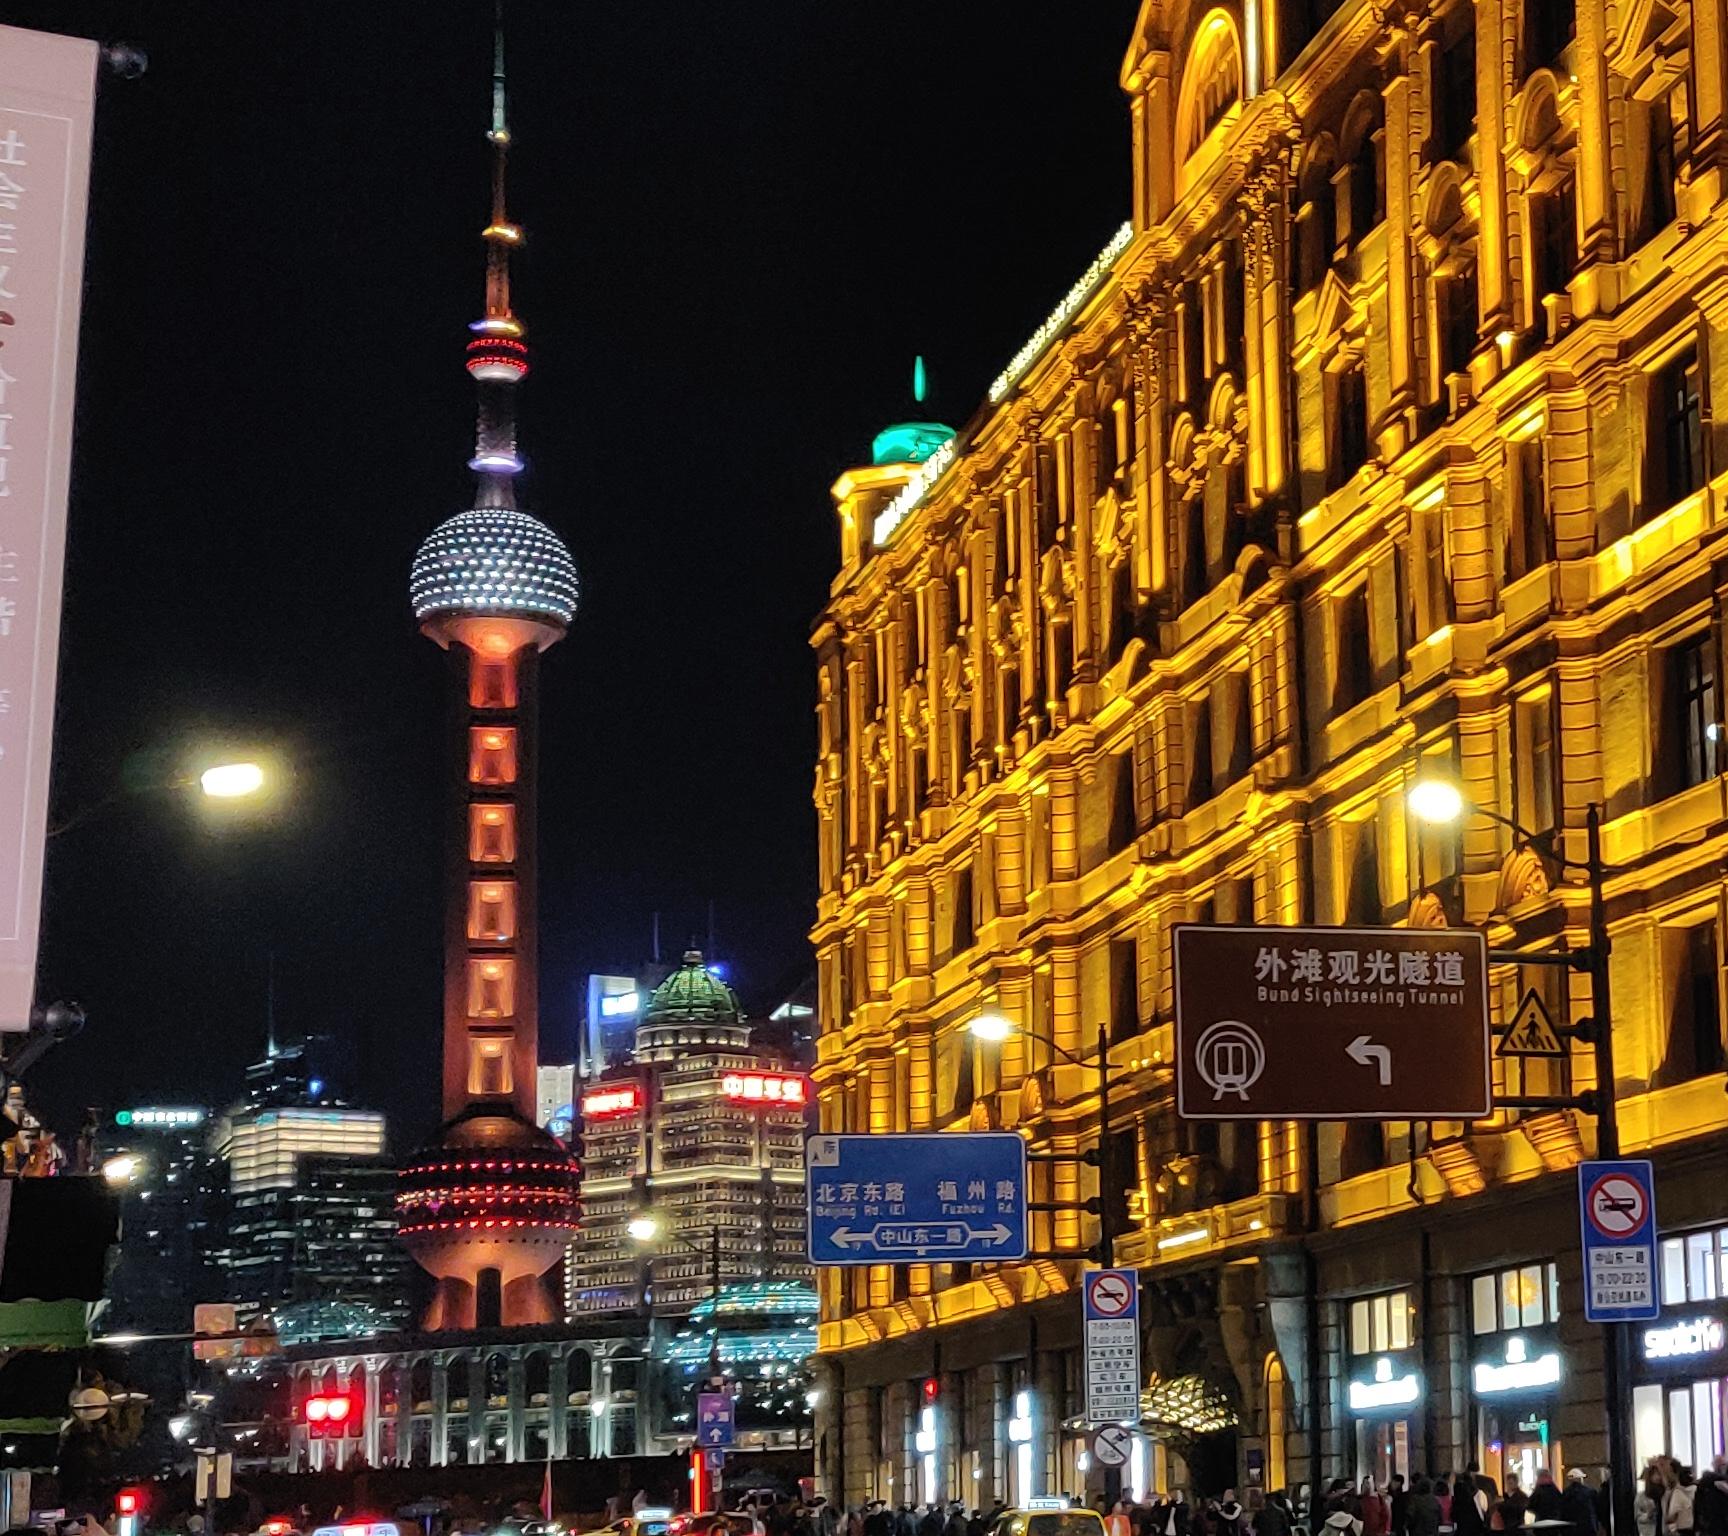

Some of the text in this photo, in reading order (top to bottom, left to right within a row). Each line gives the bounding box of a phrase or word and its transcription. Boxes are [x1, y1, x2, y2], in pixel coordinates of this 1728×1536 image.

[1254, 947, 1465, 986] 外滩观光隧道
[1257, 986, 1464, 1007] Bund Sightseeing Tunnel
[816, 1182, 904, 1203] 北京东路
[942, 1203, 1015, 1214] Fuzhou Rd.
[881, 1228, 962, 1244] 中山东一路
